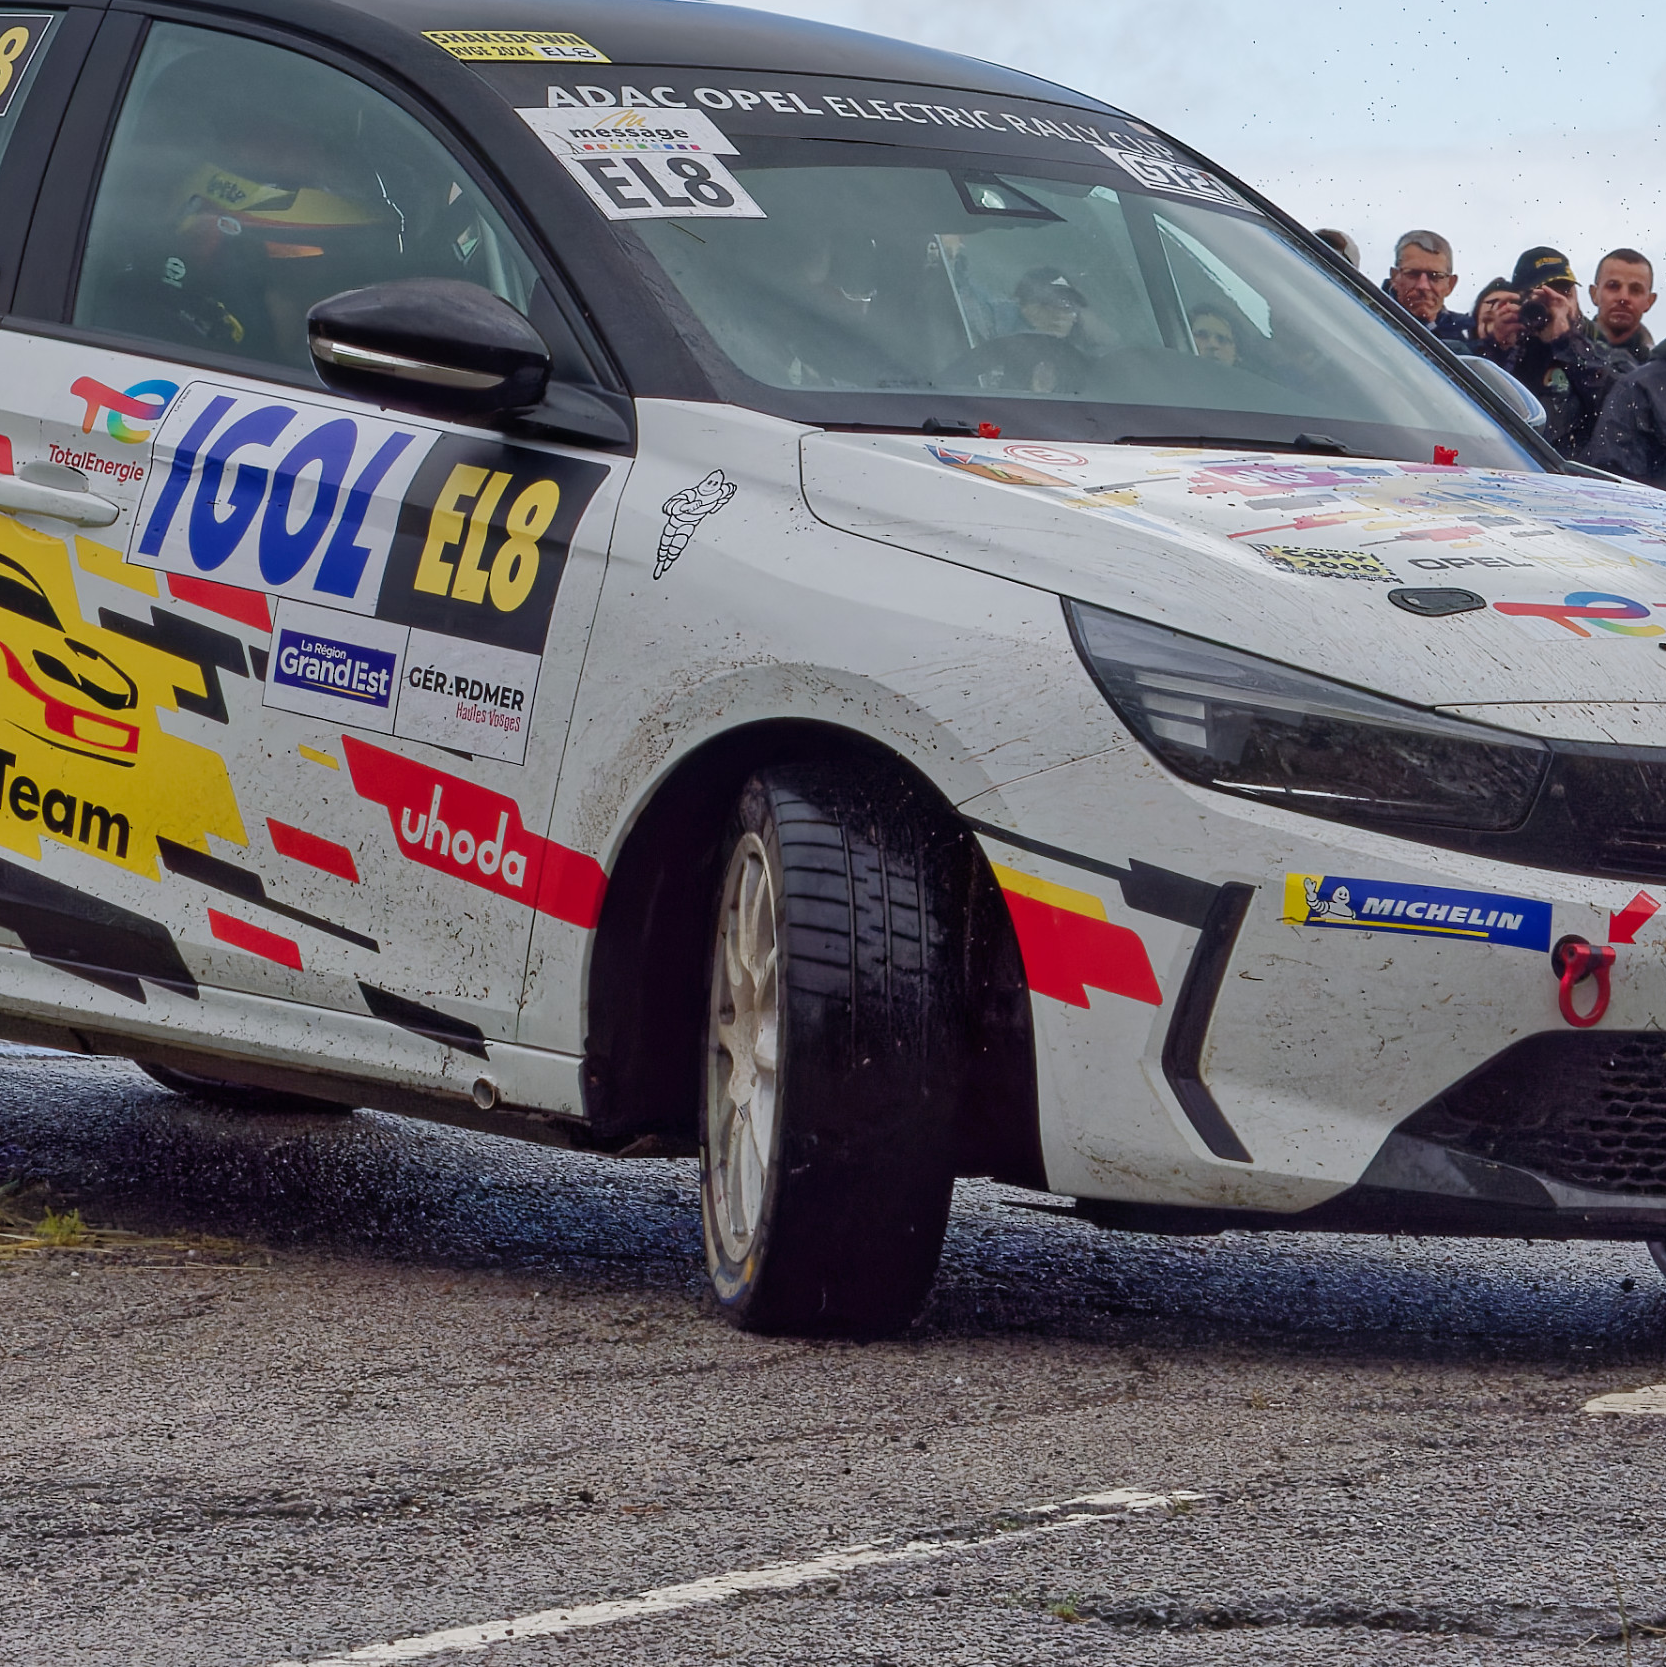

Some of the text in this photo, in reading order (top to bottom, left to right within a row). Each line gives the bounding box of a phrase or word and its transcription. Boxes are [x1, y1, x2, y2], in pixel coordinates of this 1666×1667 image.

[430, 33, 587, 46] SHAKEDOWN
[492, 46, 535, 57] 2024
[540, 46, 597, 58] EL8
[547, 85, 1175, 162] ADAC OPEL ELECTRIC RALLY CUP
[568, 127, 690, 140] message
[570, 157, 735, 210] EL8
[49, 443, 145, 483] TotalEnergie
[138, 395, 561, 613] IGOL EL8
[1407, 556, 1534, 571] OPEL
[300, 639, 347, 660] La Région
[400, 783, 528, 888] uhoda
[1361, 896, 1525, 931] MICHELIN
